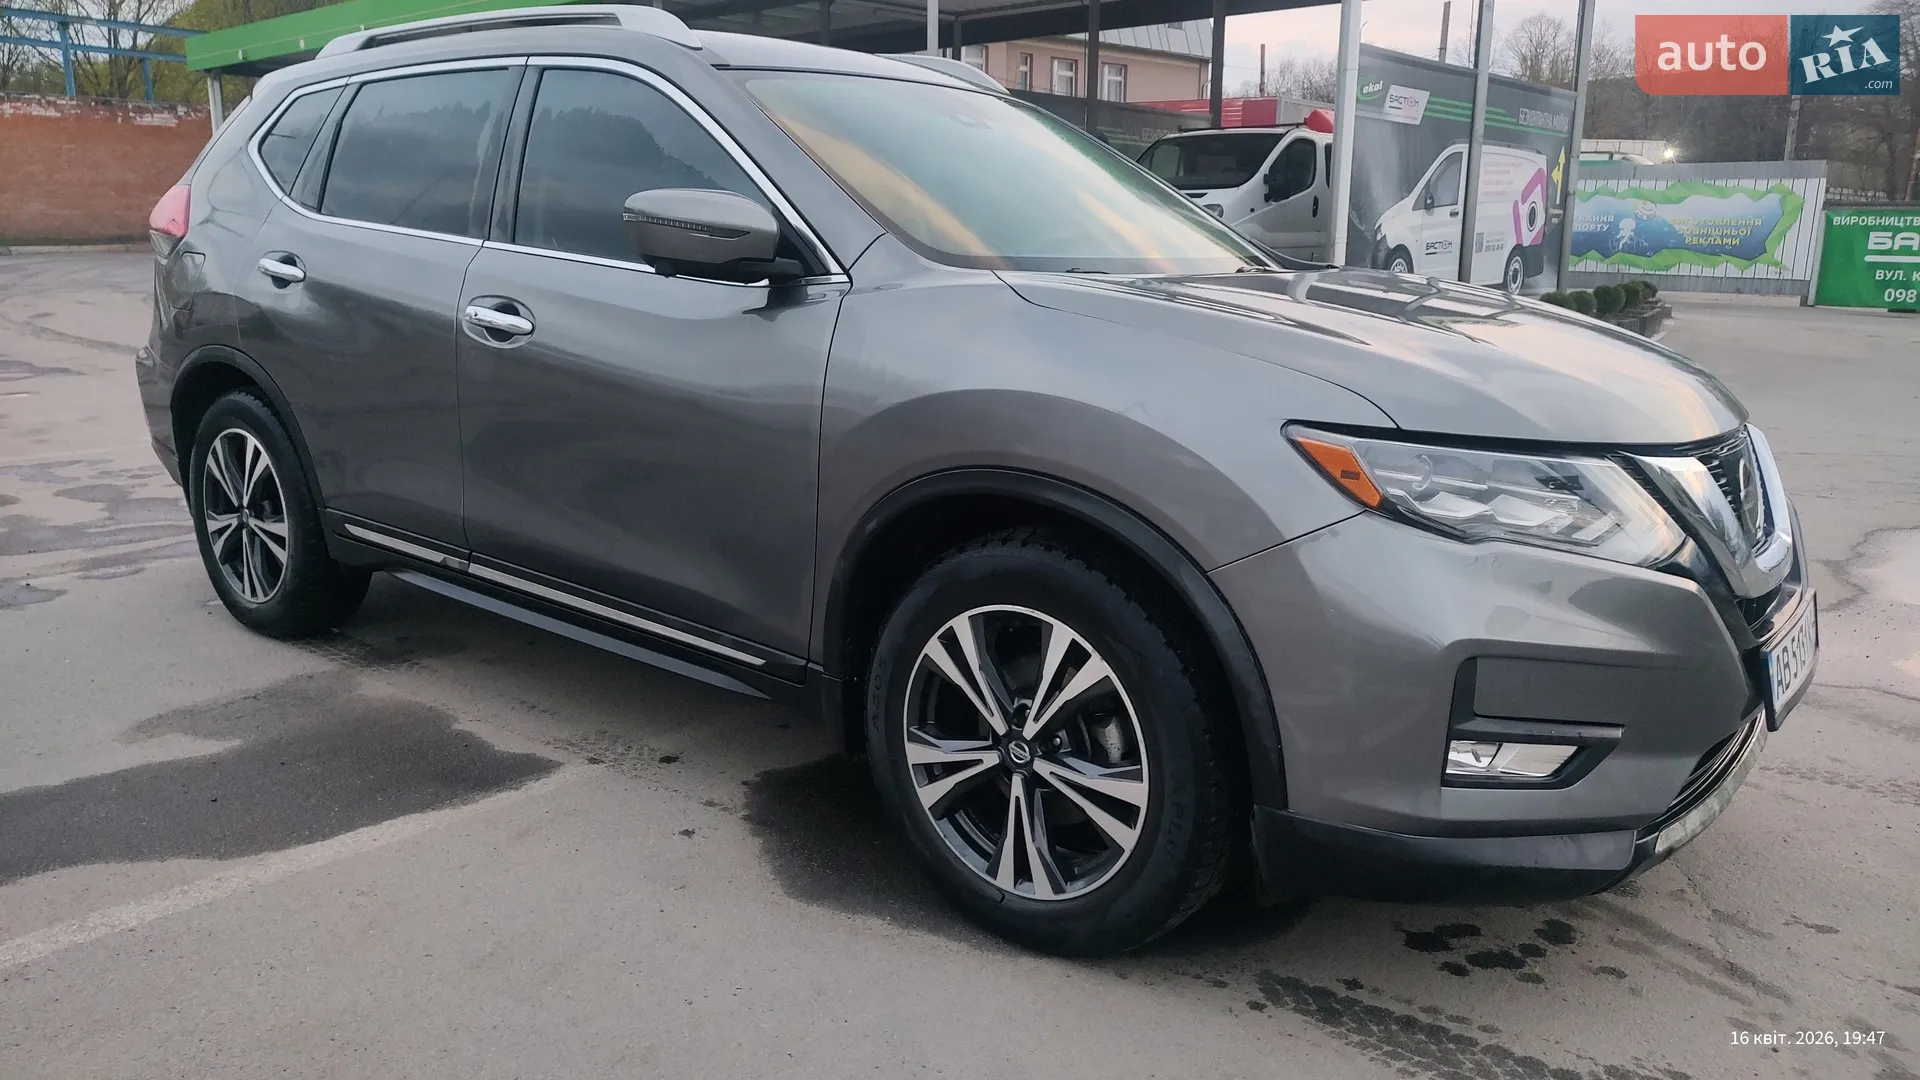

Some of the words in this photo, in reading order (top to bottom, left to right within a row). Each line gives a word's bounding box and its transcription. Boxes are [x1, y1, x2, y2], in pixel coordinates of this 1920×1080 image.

[1362, 80, 1383, 94] ekol
[1670, 217, 1763, 226] ВИГОТОВЛЕННЯ
[1678, 226, 1752, 236] ЗОВНІШНЬОЇ
[1685, 236, 1741, 245] РЕКЛАМИ
[1875, 269, 1906, 281] ВУЛ.
[1884, 288, 1917, 303] 098
